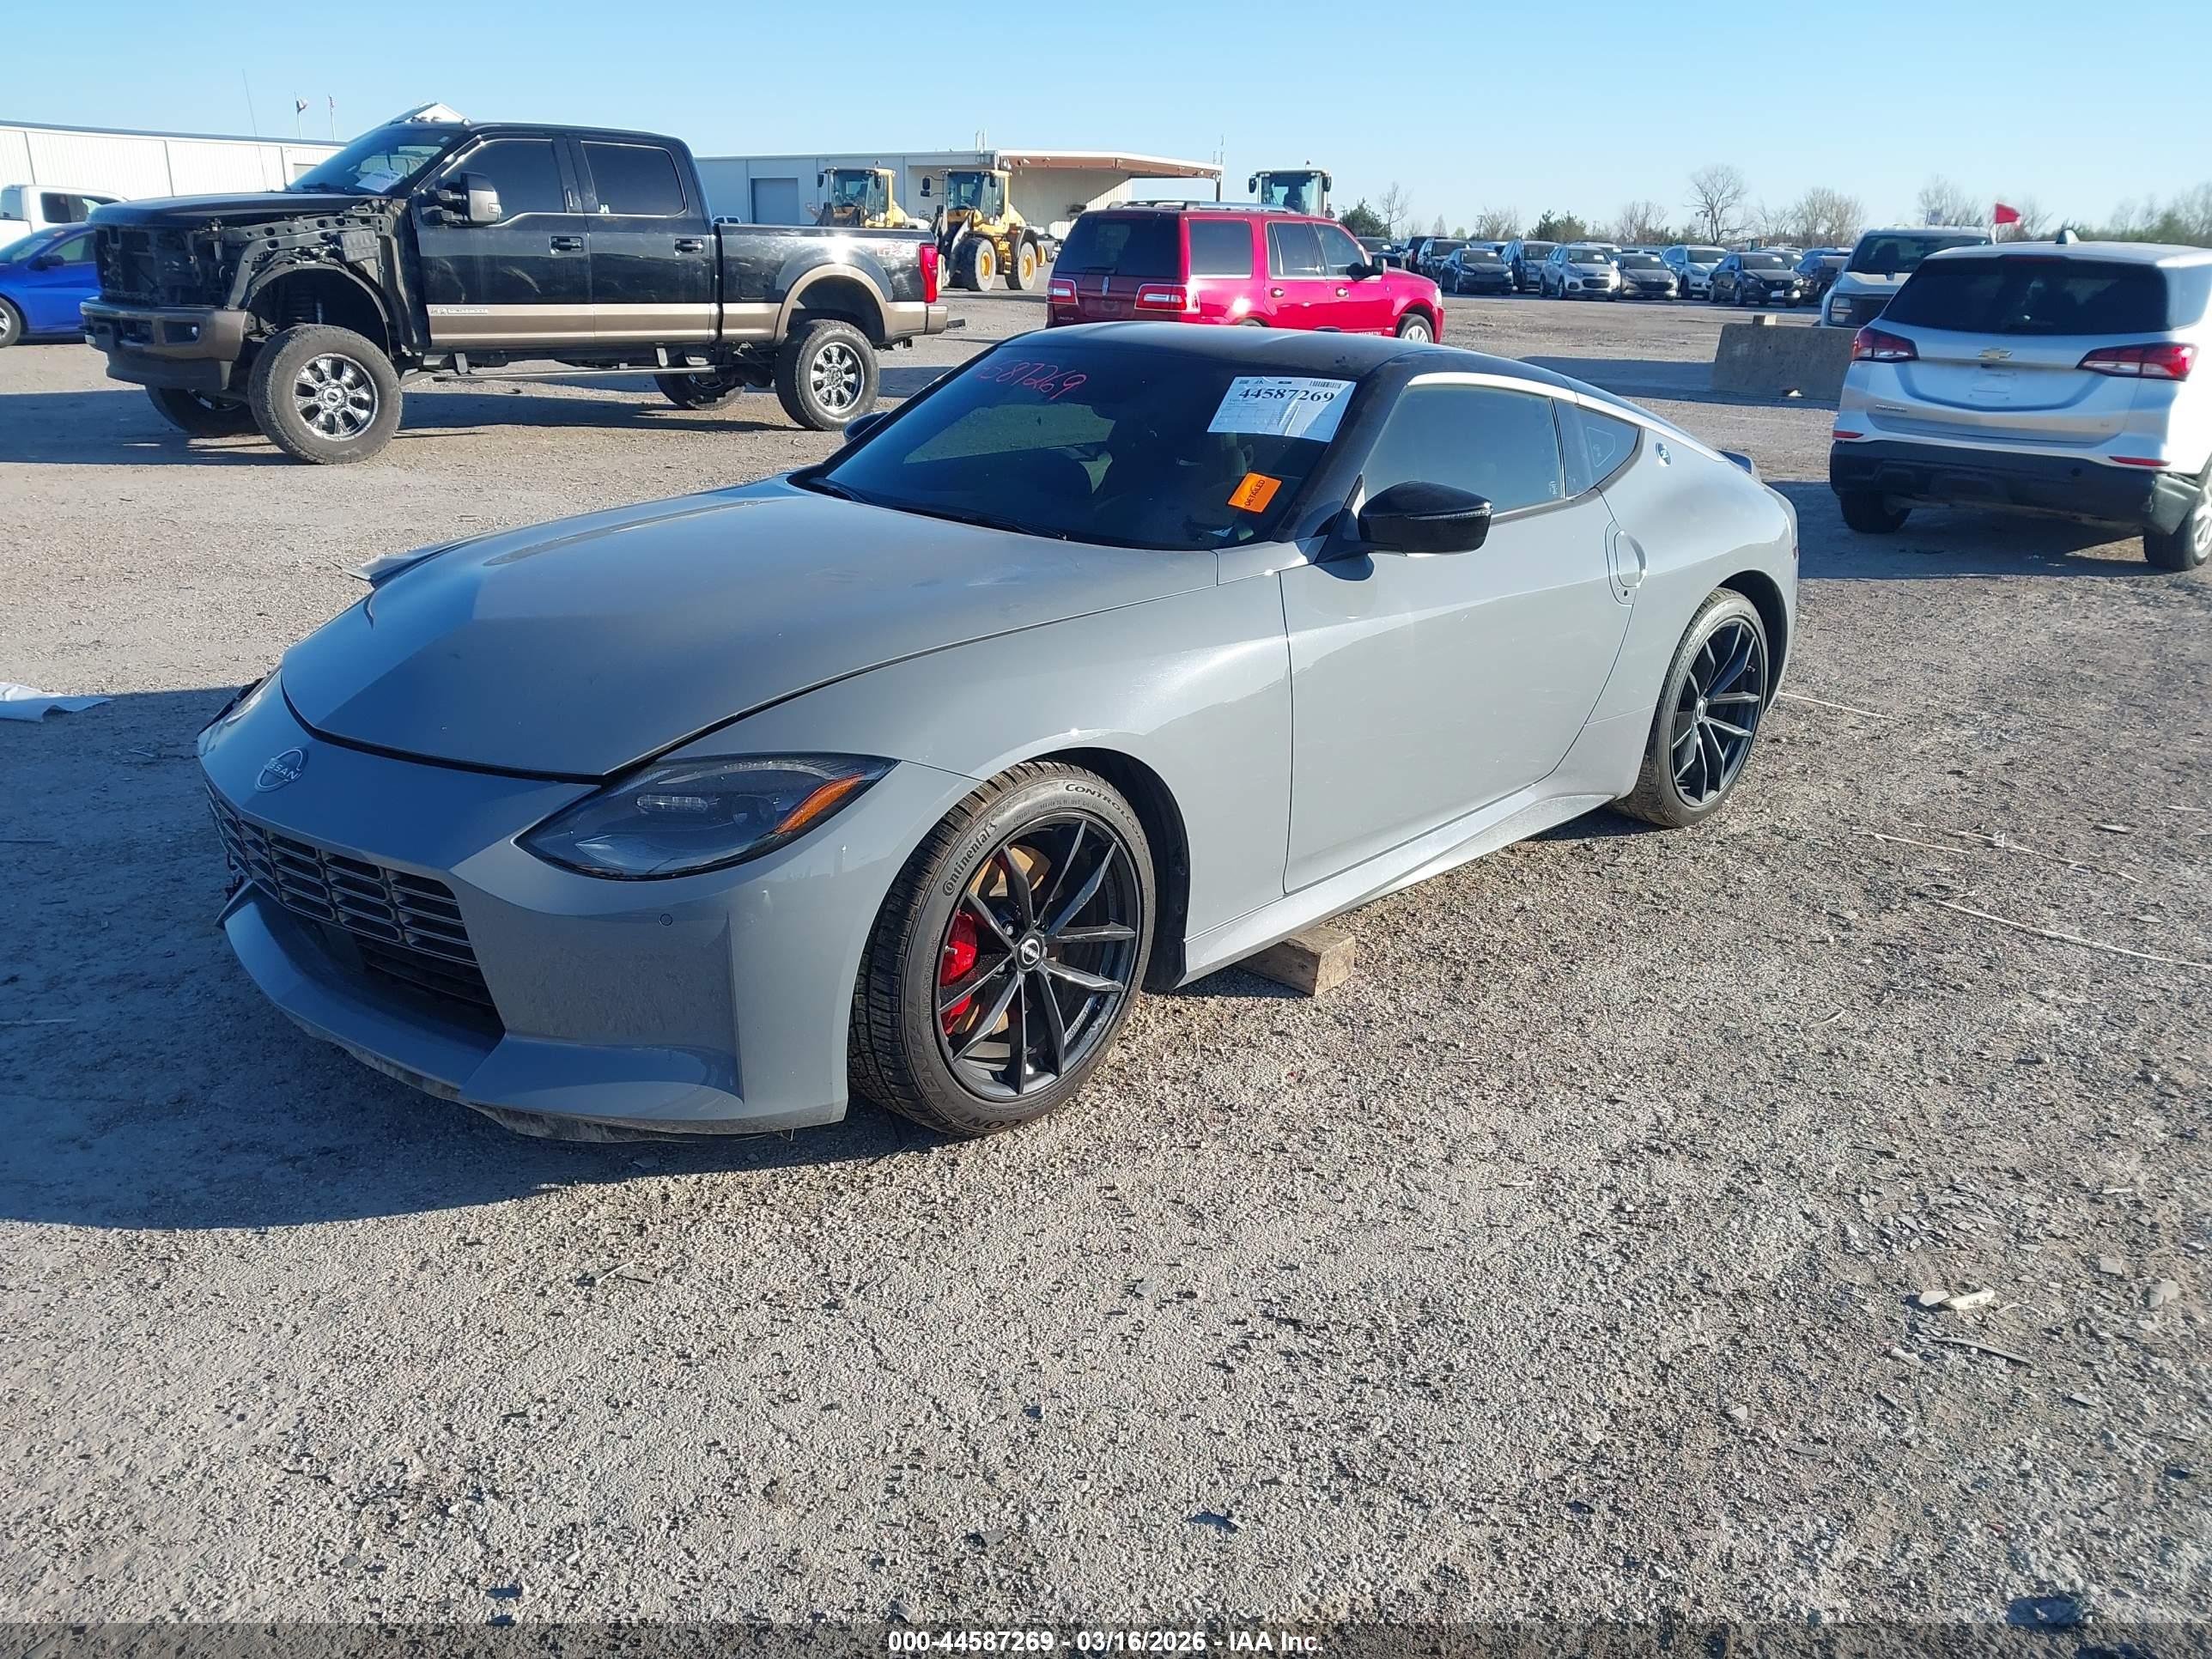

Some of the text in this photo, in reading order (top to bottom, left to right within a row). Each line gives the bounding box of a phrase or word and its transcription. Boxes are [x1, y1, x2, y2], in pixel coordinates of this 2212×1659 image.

[1239, 387, 1335, 403] 44587269
[1244, 479, 1266, 507] DETAILED
[264, 759, 300, 780] SSAN
[942, 826, 992, 896] Continental
